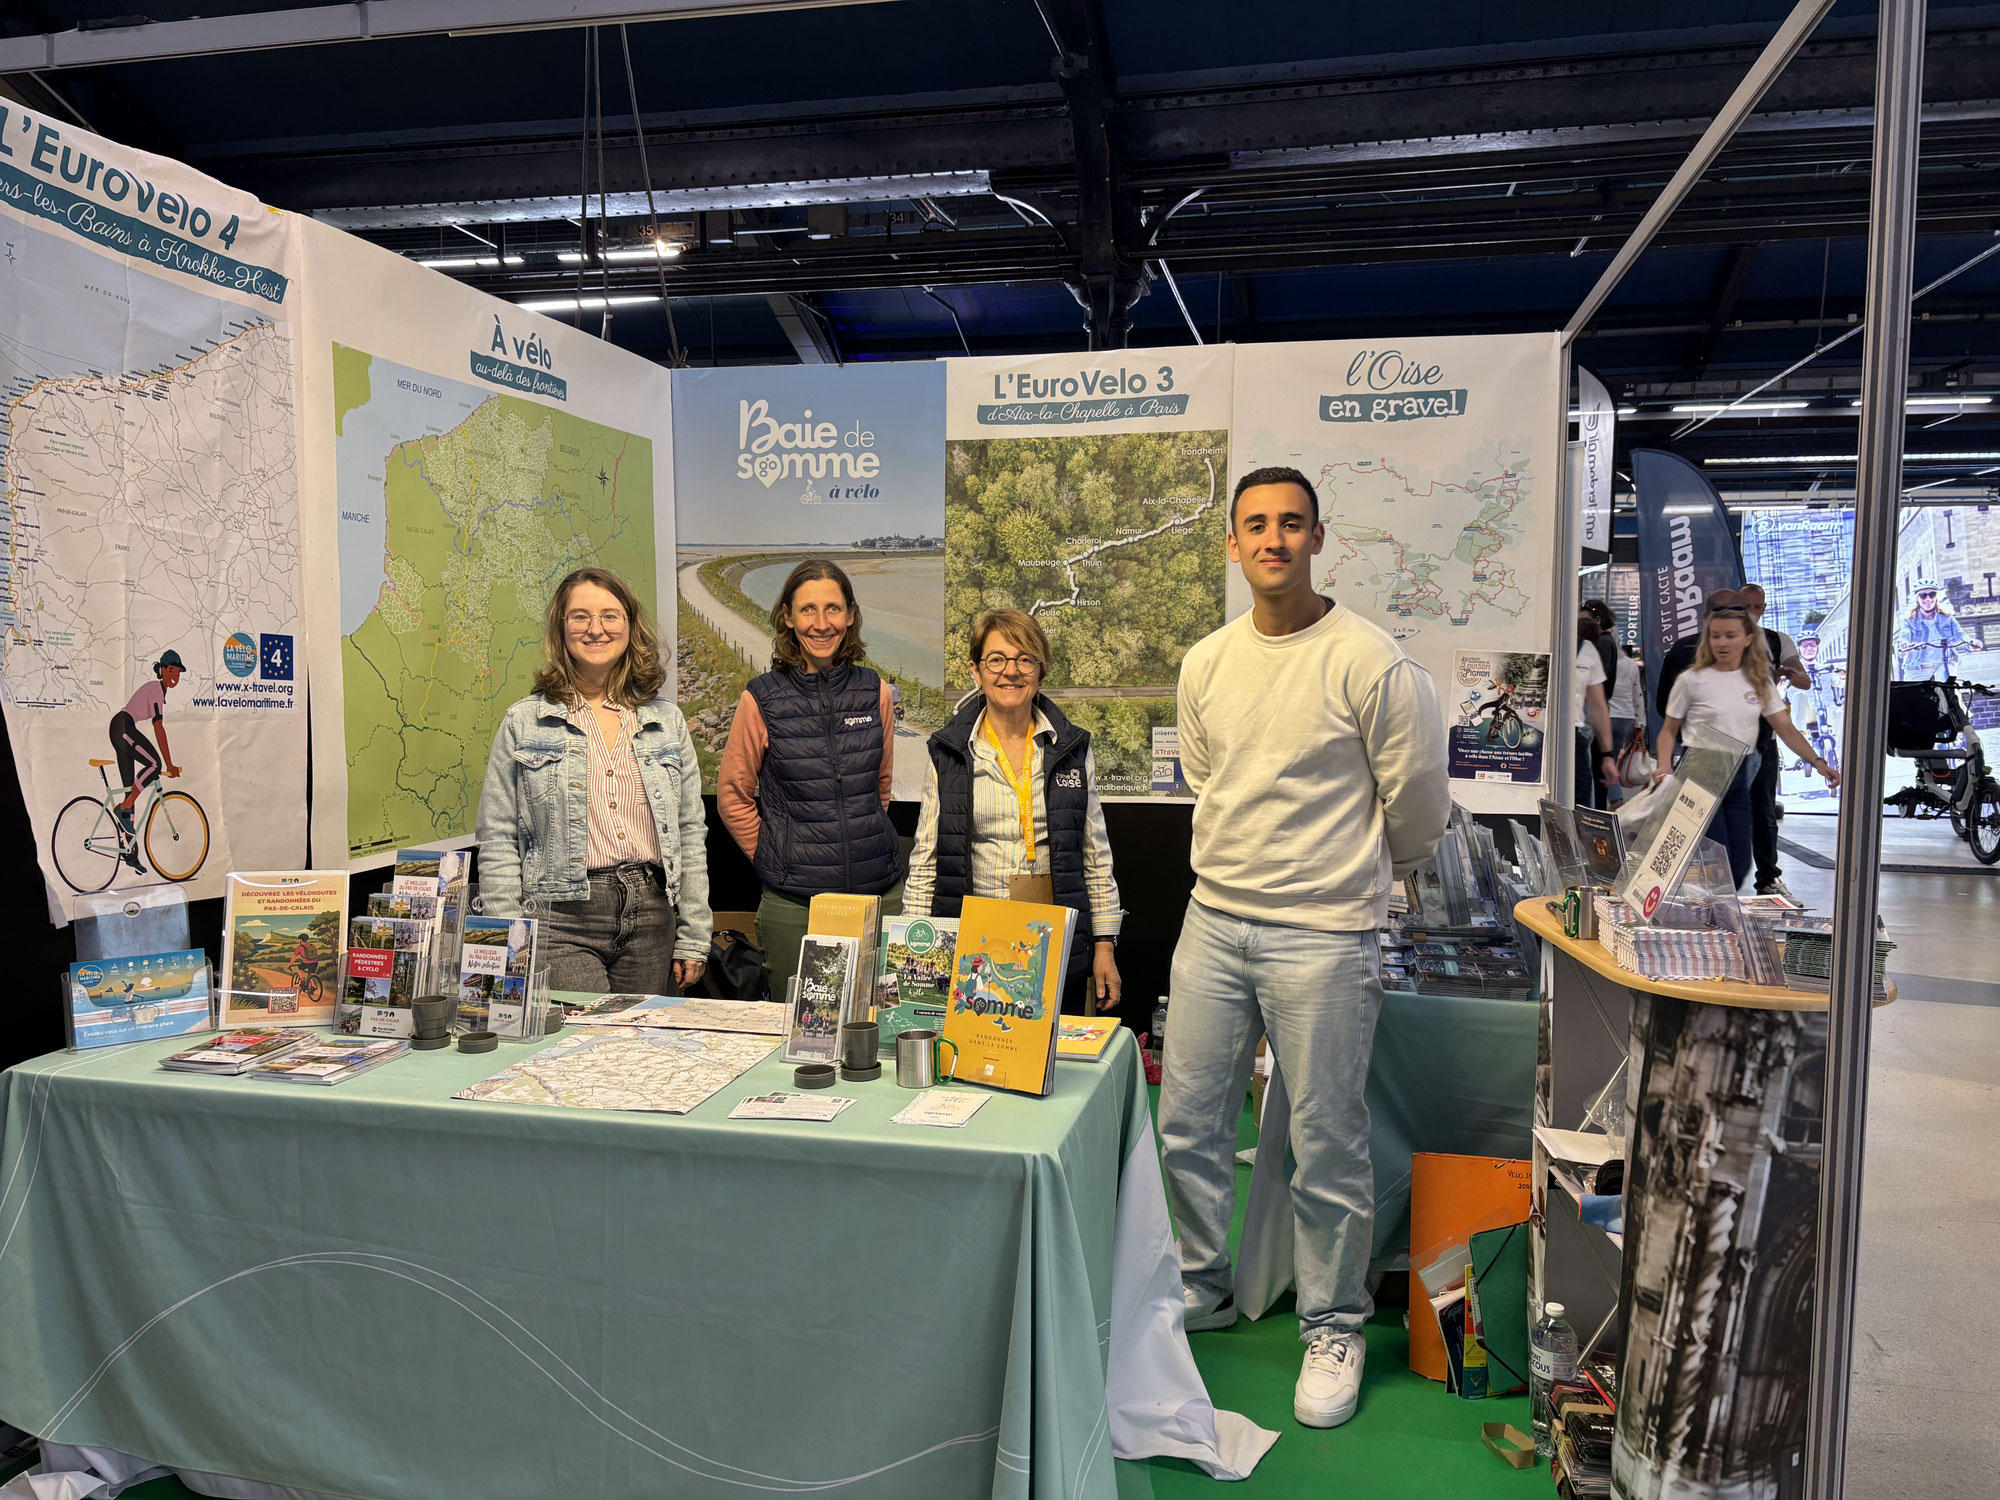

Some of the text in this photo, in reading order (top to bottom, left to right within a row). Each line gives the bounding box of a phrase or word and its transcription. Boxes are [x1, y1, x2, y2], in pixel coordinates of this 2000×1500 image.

[0, 105, 239, 250] L'EuroVelo 4
[639, 225, 654, 236] 35
[0, 178, 280, 300] ers-les-Bains à Knokke-Heist
[491, 314, 552, 370] À vélo
[1347, 350, 1443, 390] l'Oise
[475, 361, 566, 399] au-delà des frontières
[995, 366, 1174, 399] L'EuroVelo 3
[396, 378, 442, 399] MER DU NORD
[987, 399, 1180, 424] d'Aix-la-Chapelle à Paris
[1328, 391, 1460, 423] en gravel
[740, 399, 874, 454] Baie de
[1181, 446, 1223, 456] Trondheim
[736, 452, 880, 488] somme
[829, 484, 880, 499] à vélo
[1142, 496, 1207, 506] Aix-la-Chapelle
[342, 511, 370, 523] MANCHE
[1116, 527, 1142, 535] Namur
[1778, 520, 1838, 531] vanRaam
[1066, 536, 1102, 545] Charleroi
[1018, 558, 1061, 568] Maubeuge
[1077, 598, 1100, 606] Hirson
[1039, 608, 1061, 617] Guise
[271, 649, 282, 667] 4
[216, 682, 293, 695] www.x-travel.org
[192, 697, 294, 708] www.lavelomaritime.fr
[844, 716, 872, 726] somme
[1095, 774, 1148, 782] w.x-travel.org
[804, 977, 828, 992] Baie
[911, 980, 935, 988] Somme
[802, 992, 836, 1001] somme
[964, 996, 1034, 1020] somme
[976, 1033, 1013, 1044] RANDONNER
[997, 1044, 1018, 1052] SOMME
